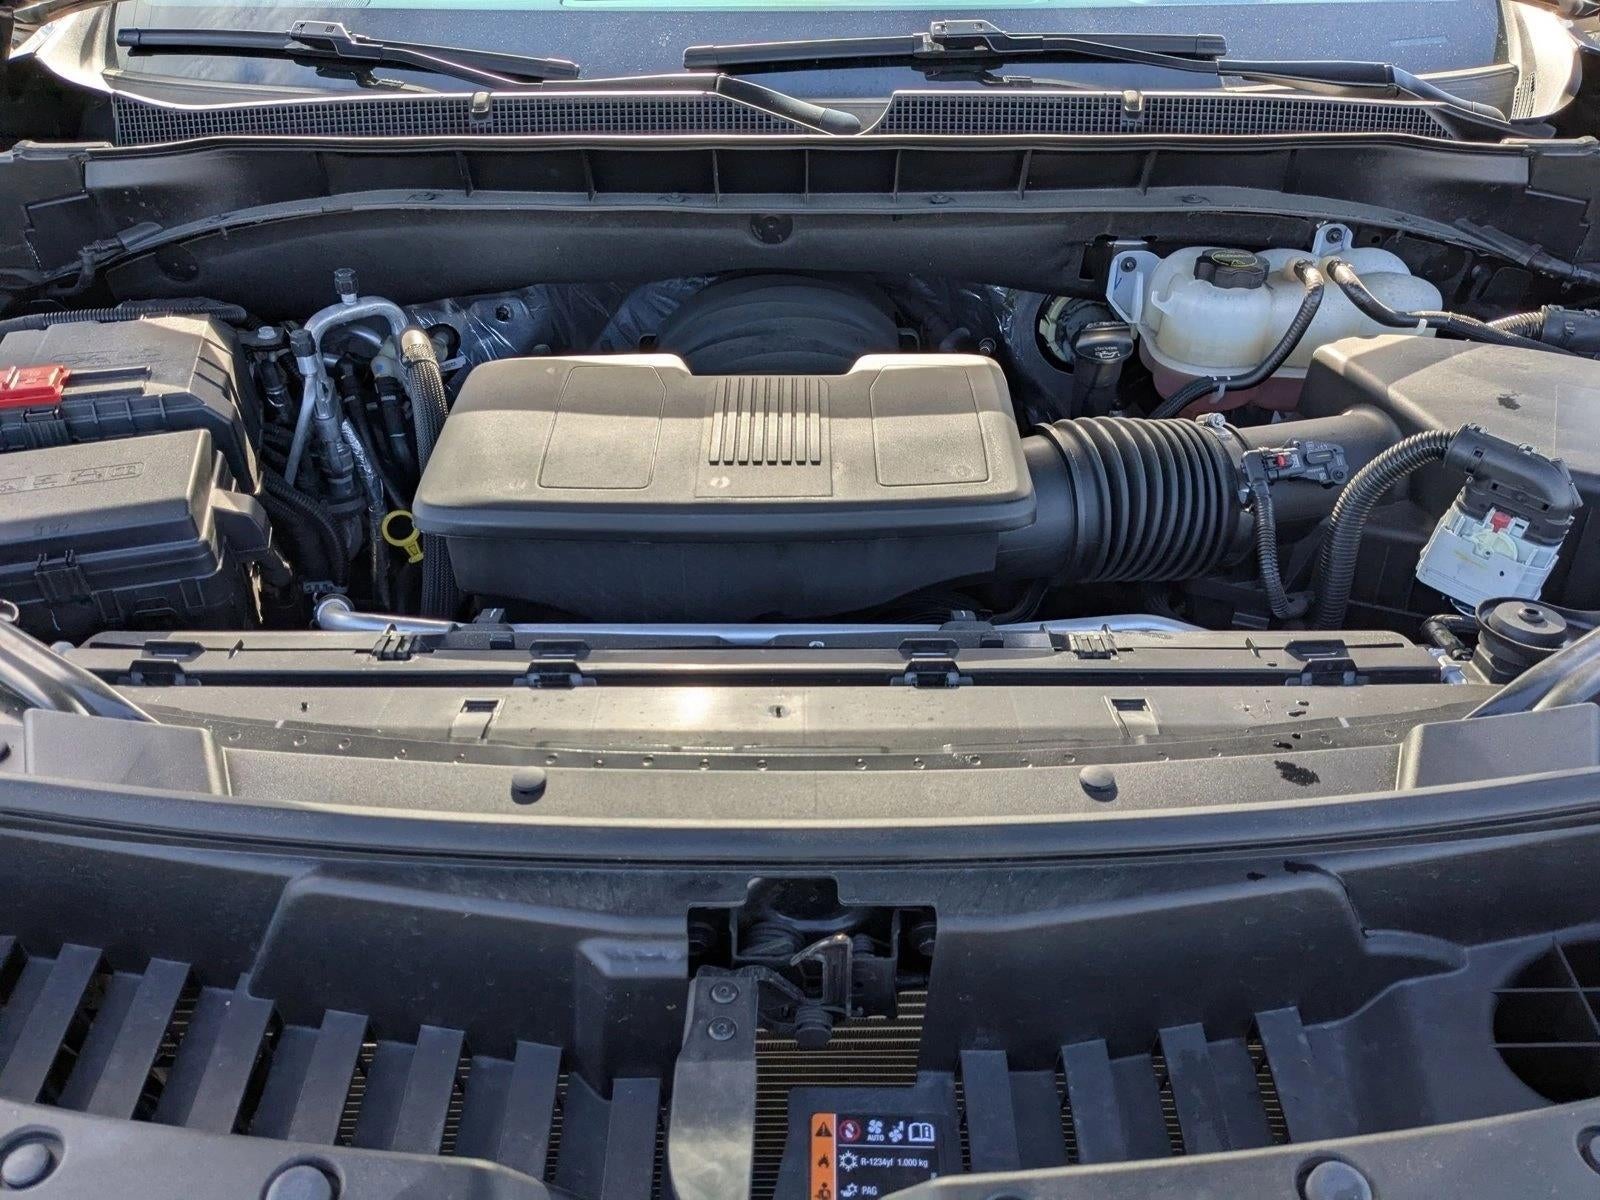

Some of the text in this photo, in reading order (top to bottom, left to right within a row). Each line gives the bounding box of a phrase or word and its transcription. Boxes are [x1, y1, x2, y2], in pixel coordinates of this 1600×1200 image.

[867, 1134, 884, 1142] AUTO
[860, 1157, 928, 1168] R-1234yf 1.000 kg
[861, 1185, 878, 1196] PAG
